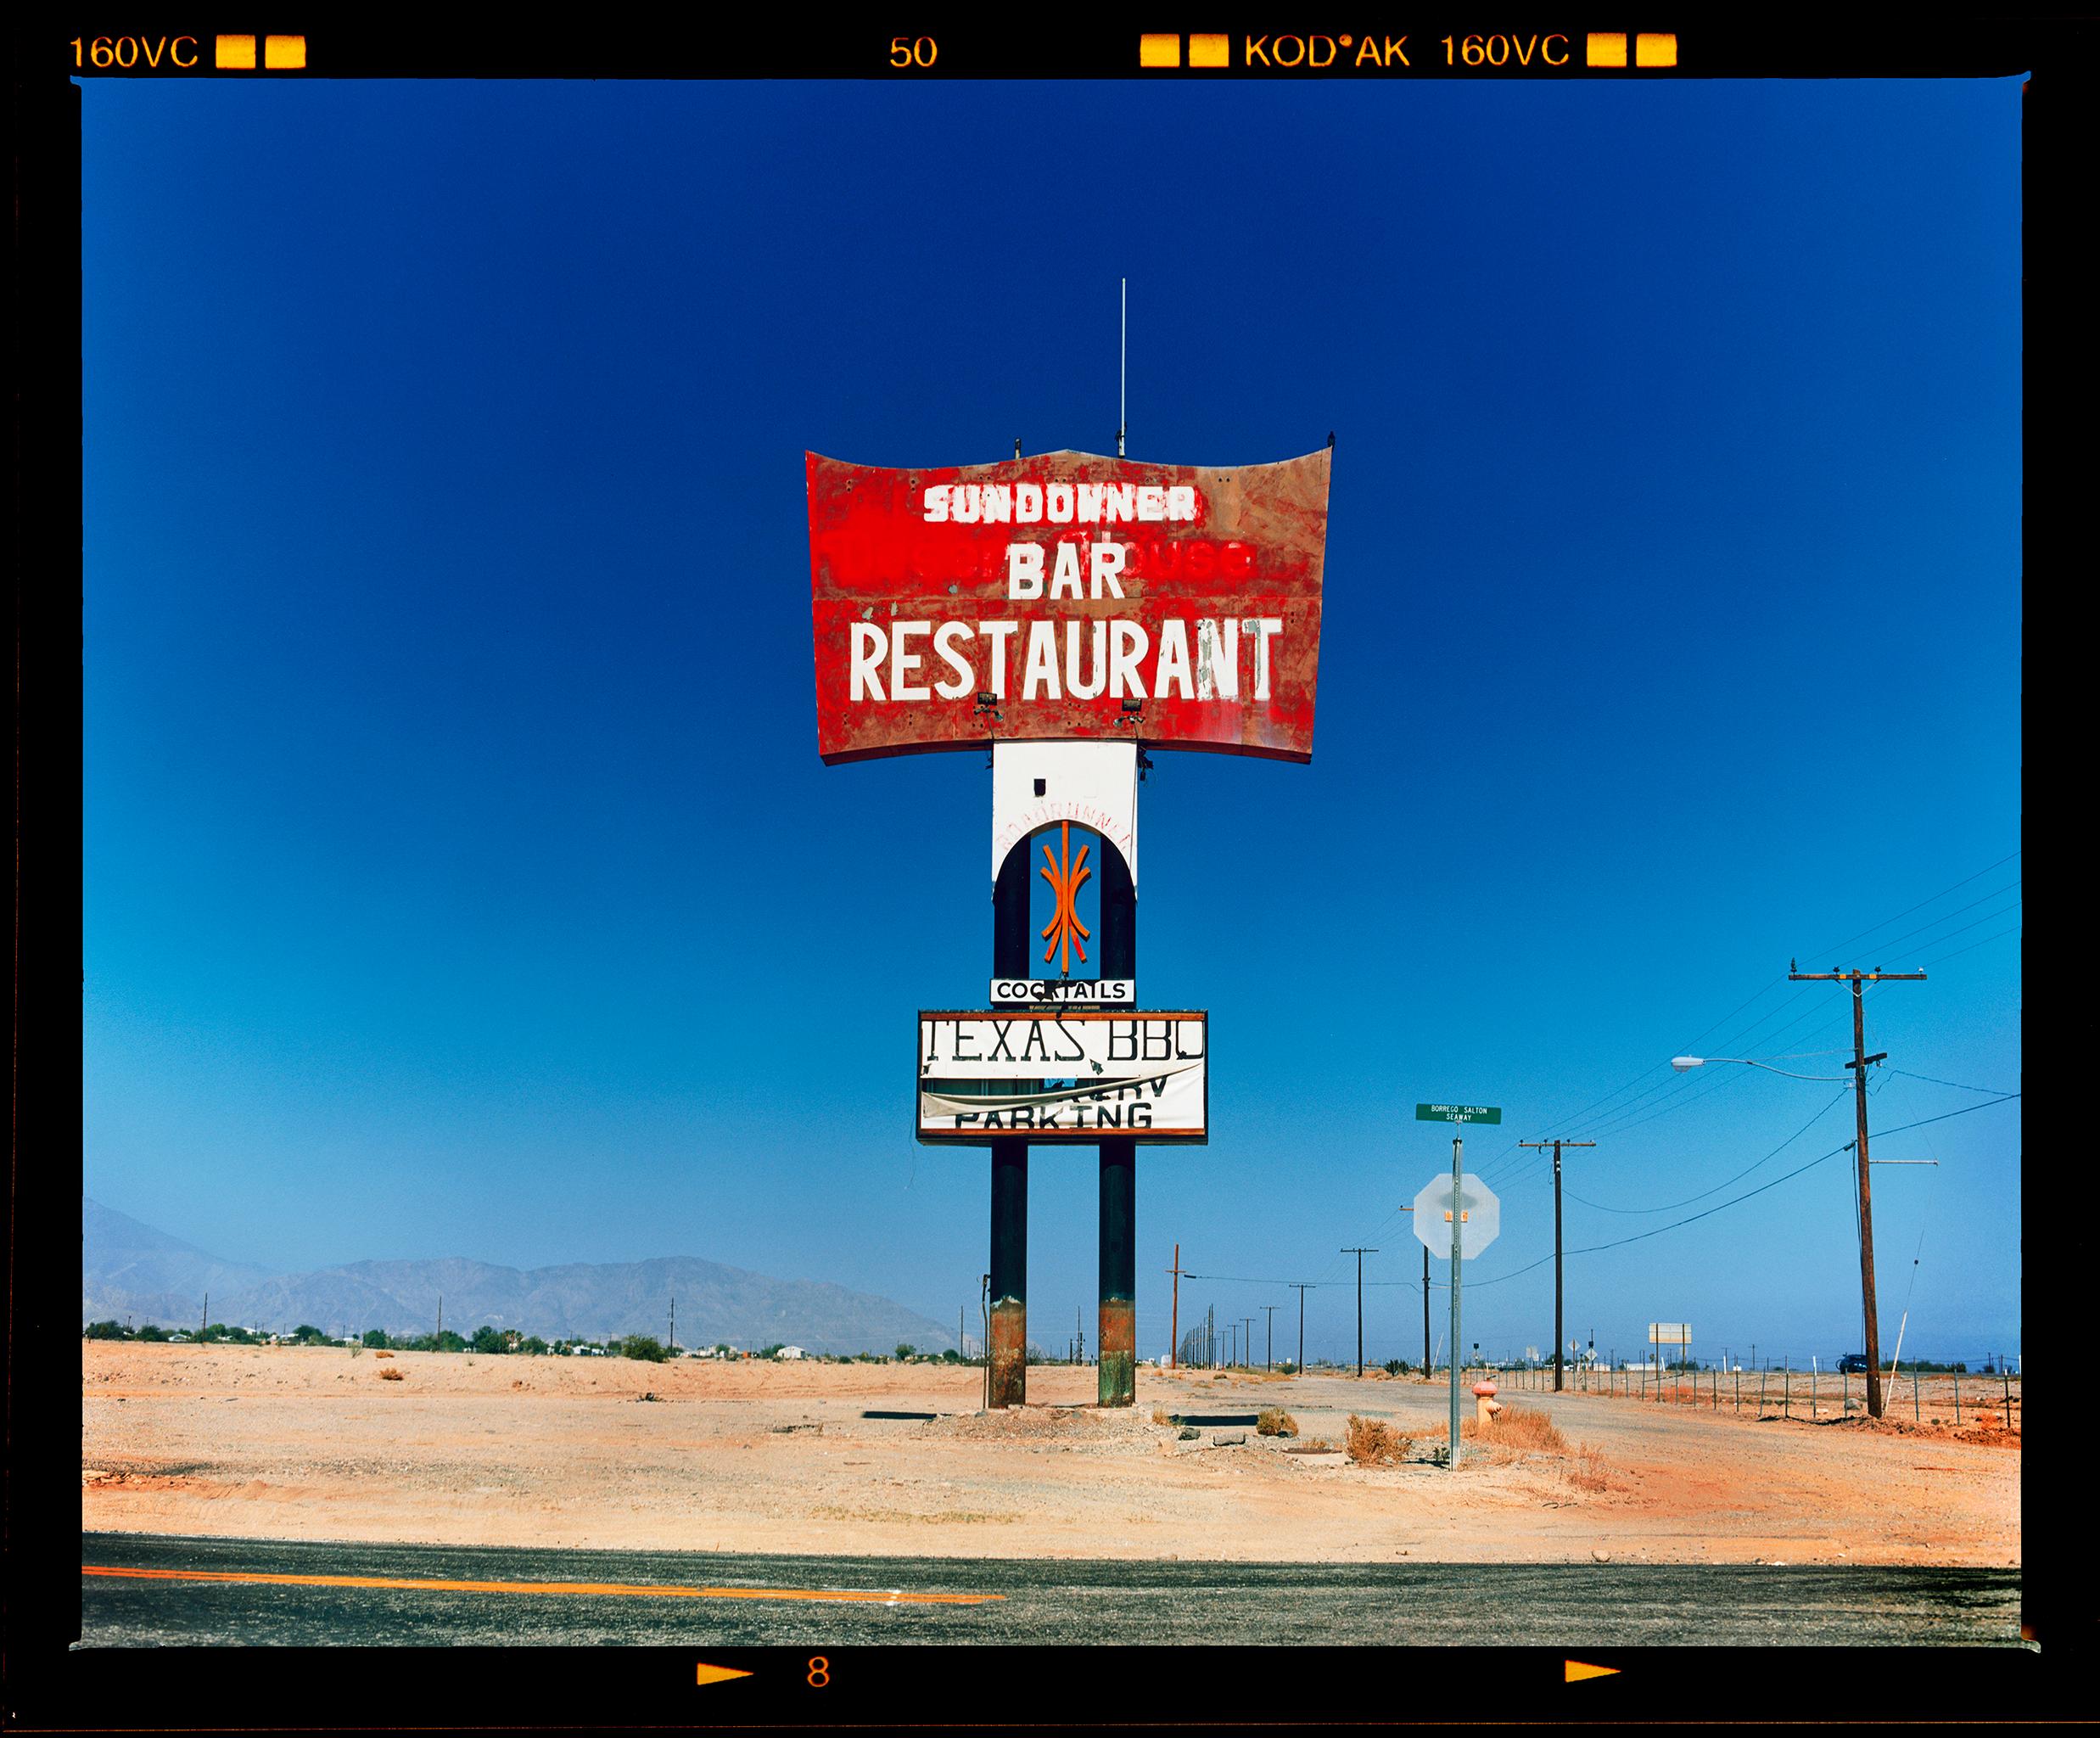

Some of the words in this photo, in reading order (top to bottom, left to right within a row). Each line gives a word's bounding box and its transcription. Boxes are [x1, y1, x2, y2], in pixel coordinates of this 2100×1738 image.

[70, 36, 199, 68] 160VC
[890, 36, 938, 67] 50
[1441, 34, 1570, 65] 160VC
[923, 483, 1198, 523] SUNDOWNER
[1006, 541, 1127, 599] BAR
[850, 618, 1282, 702] RESTAURANT
[926, 1020, 1085, 1061] TEXAS
[1107, 1020, 1204, 1061] BBQ
[955, 1102, 1152, 1129] PARKING
[1431, 1105, 1459, 1113] BORREGO
[807, 1656, 830, 1687] 8
